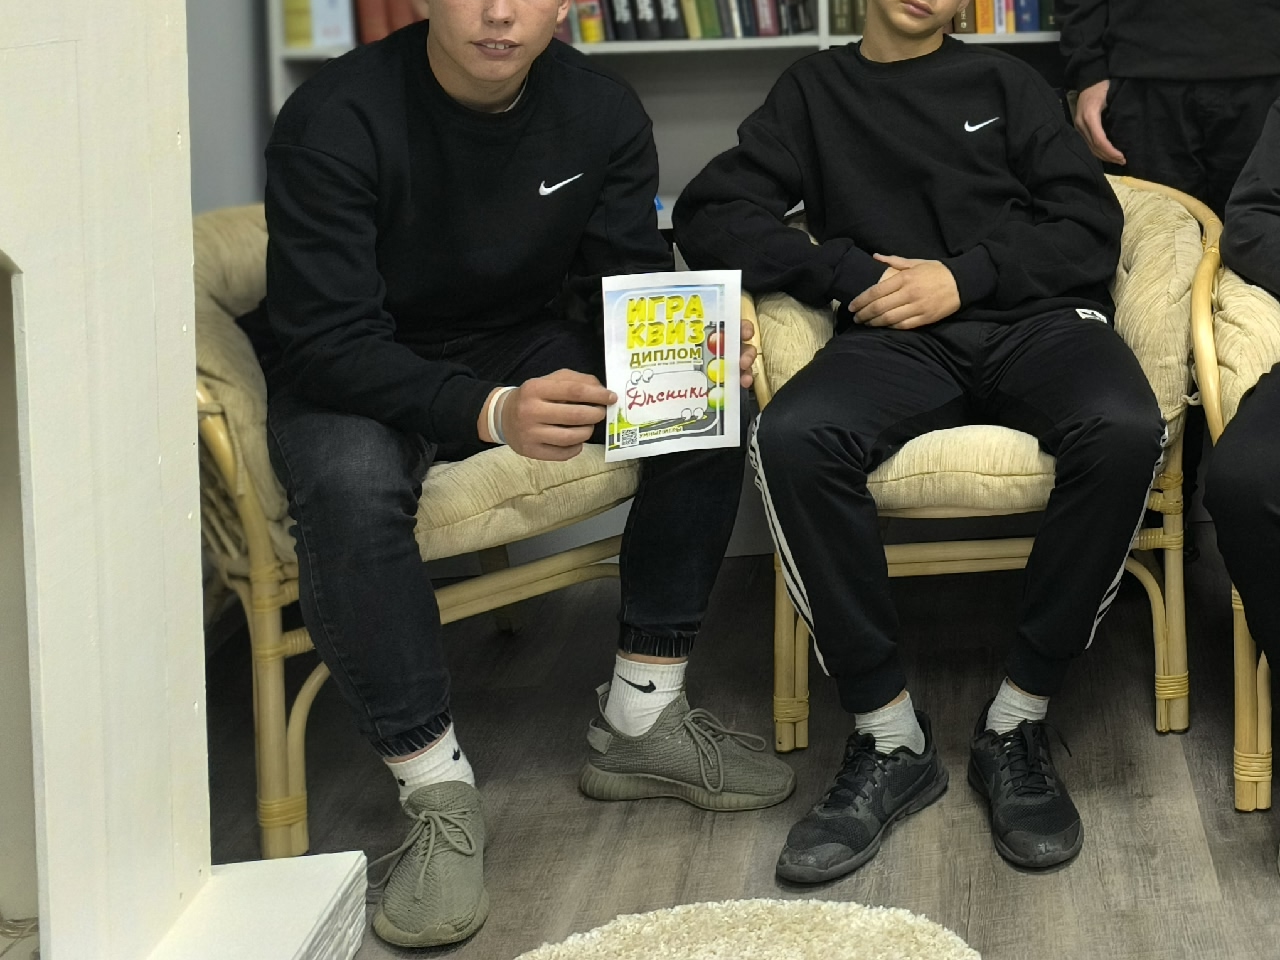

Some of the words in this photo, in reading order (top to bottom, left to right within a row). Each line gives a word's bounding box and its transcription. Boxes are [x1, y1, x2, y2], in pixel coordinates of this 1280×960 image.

[626, 294, 705, 324] ИГРА
[626, 319, 706, 350] КВИЗ
[630, 347, 702, 369] ДИПЛОМ
